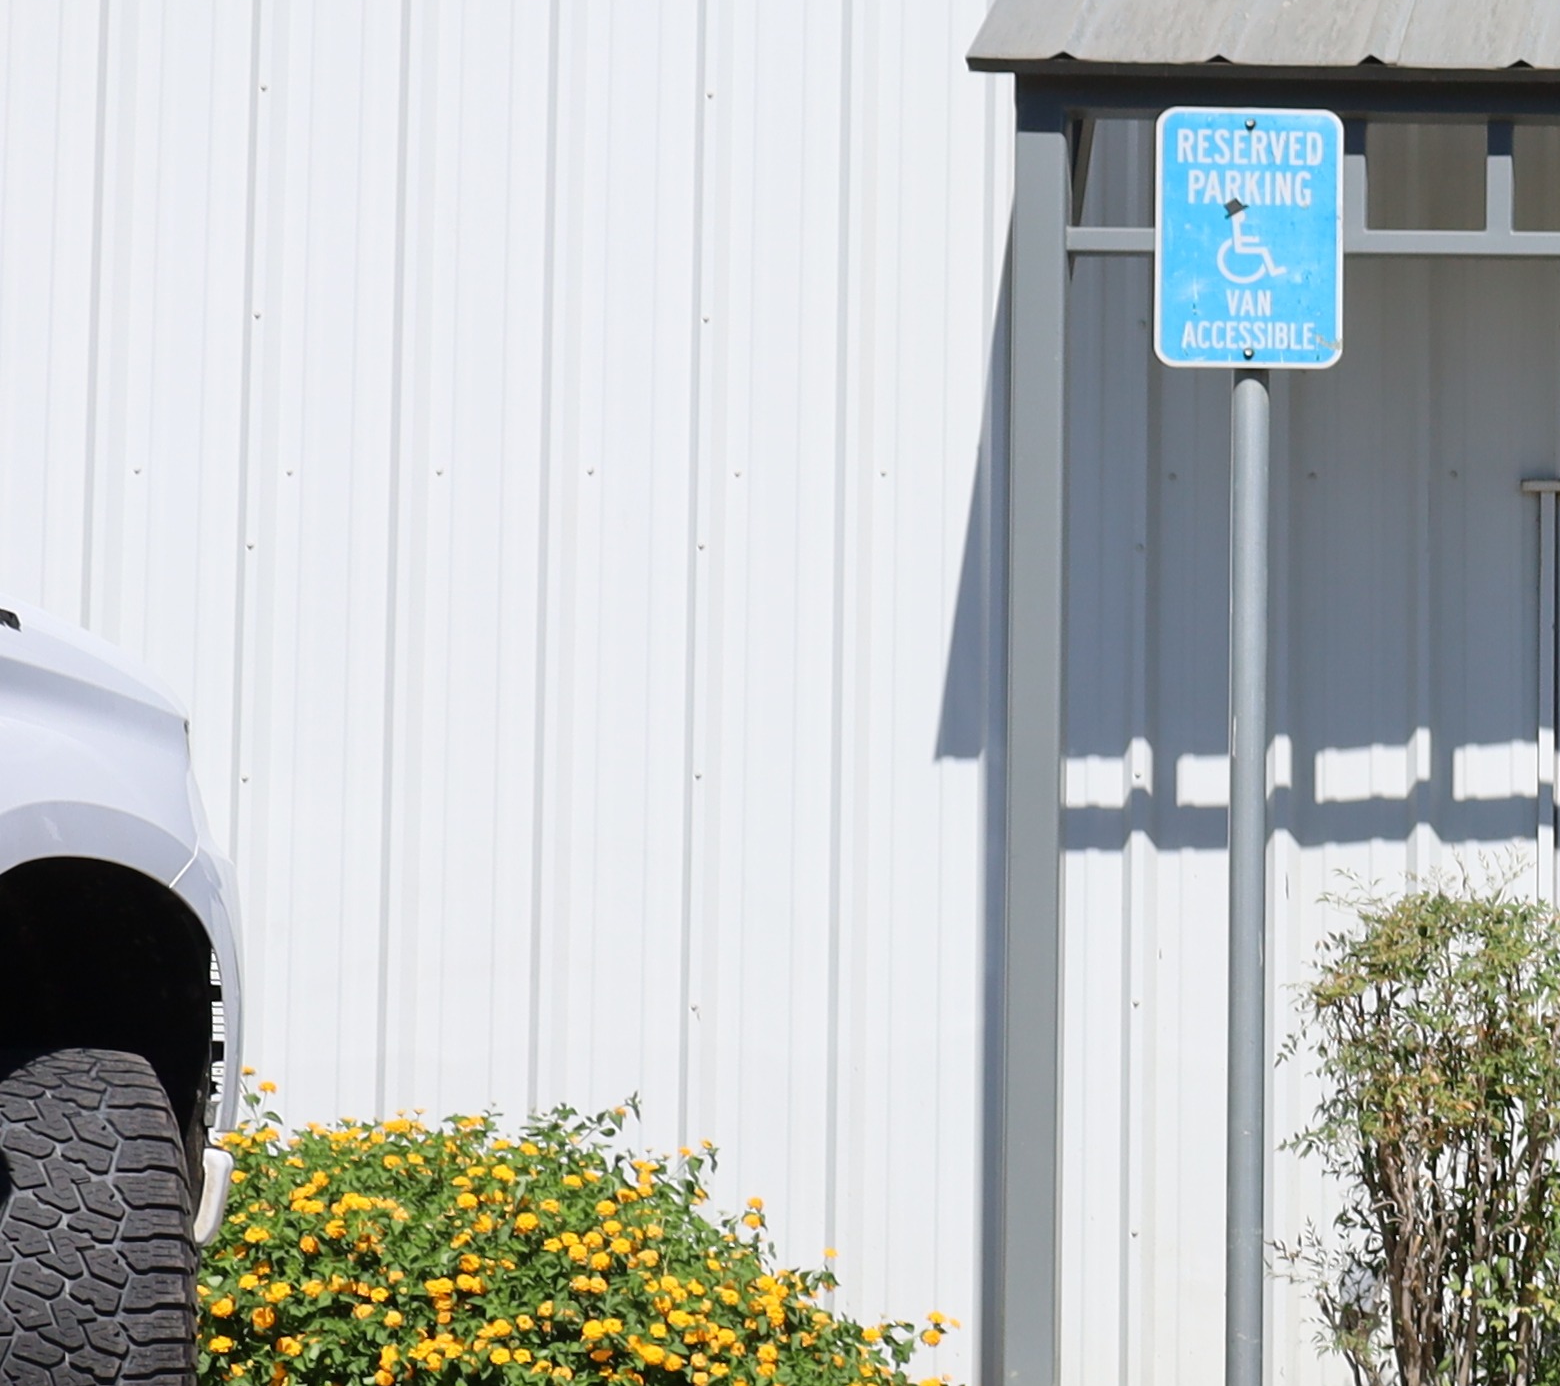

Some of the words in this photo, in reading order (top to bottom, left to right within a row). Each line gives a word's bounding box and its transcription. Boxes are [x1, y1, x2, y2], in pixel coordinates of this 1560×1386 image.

[1177, 129, 1323, 166] RESERVED
[1188, 170, 1311, 207] PARKING
[1226, 289, 1272, 317] VAN
[1181, 321, 1316, 351] ACCESSIBLE
